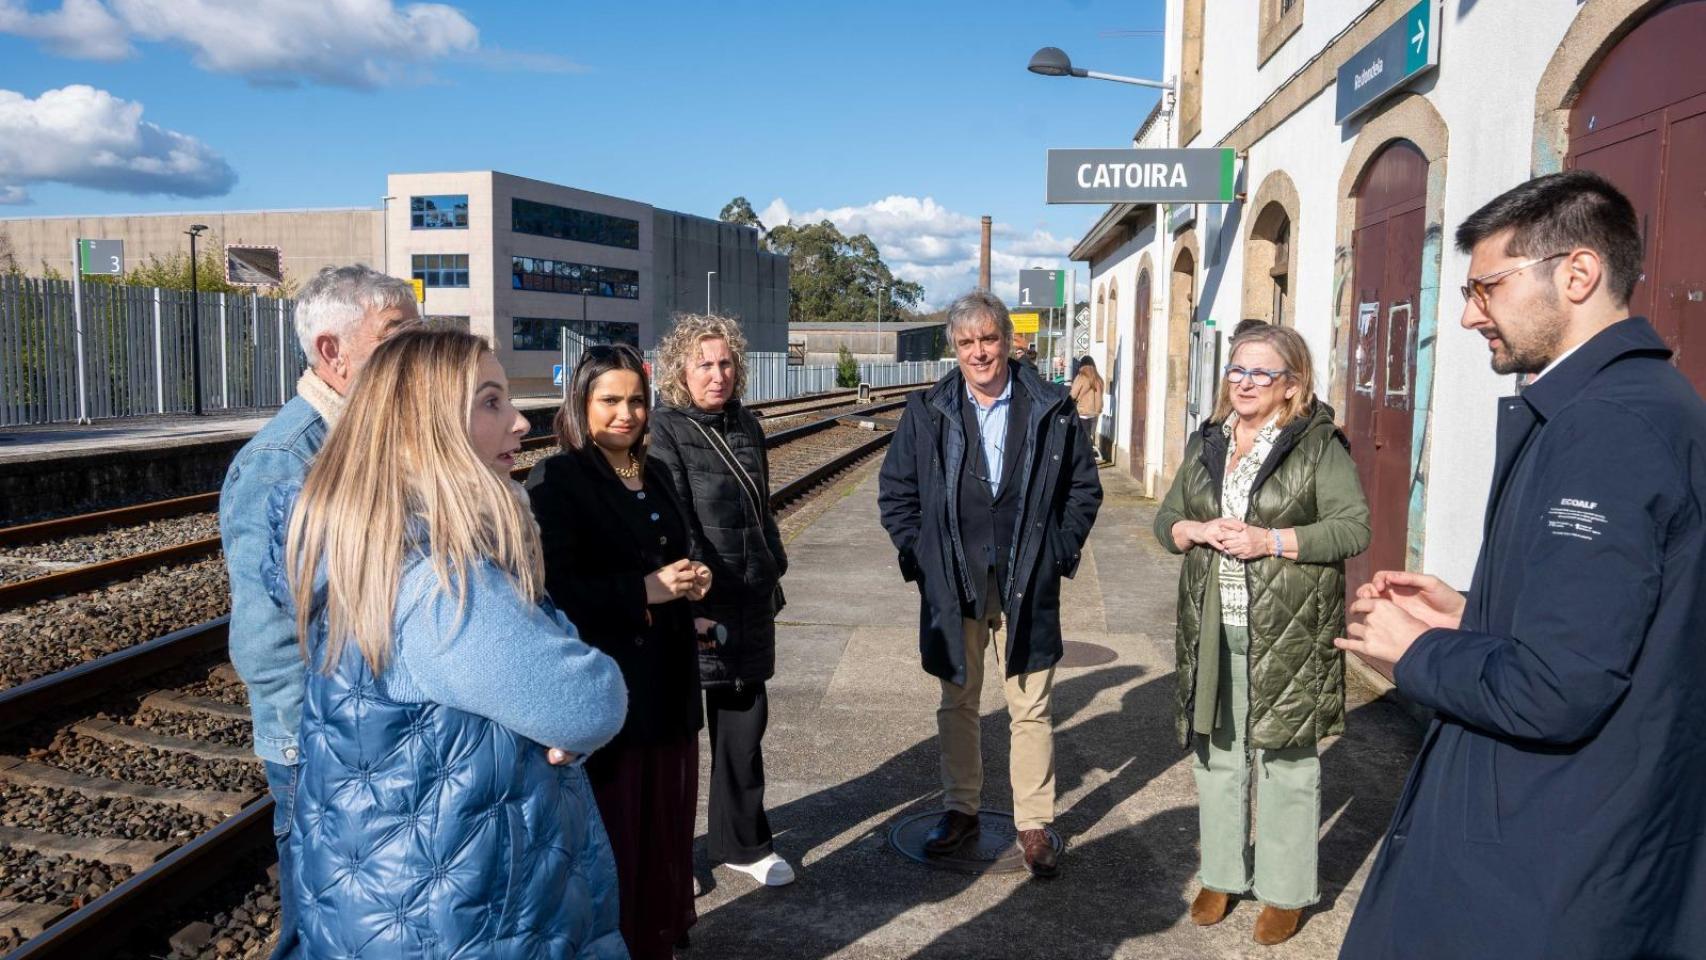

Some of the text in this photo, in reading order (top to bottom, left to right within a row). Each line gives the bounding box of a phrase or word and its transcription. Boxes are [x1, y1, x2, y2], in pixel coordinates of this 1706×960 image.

[1077, 163, 1188, 189] CATOIRA
[110, 256, 120, 273] 3
[1021, 287, 1032, 305] 1
[1559, 498, 1598, 510] ECOALF
